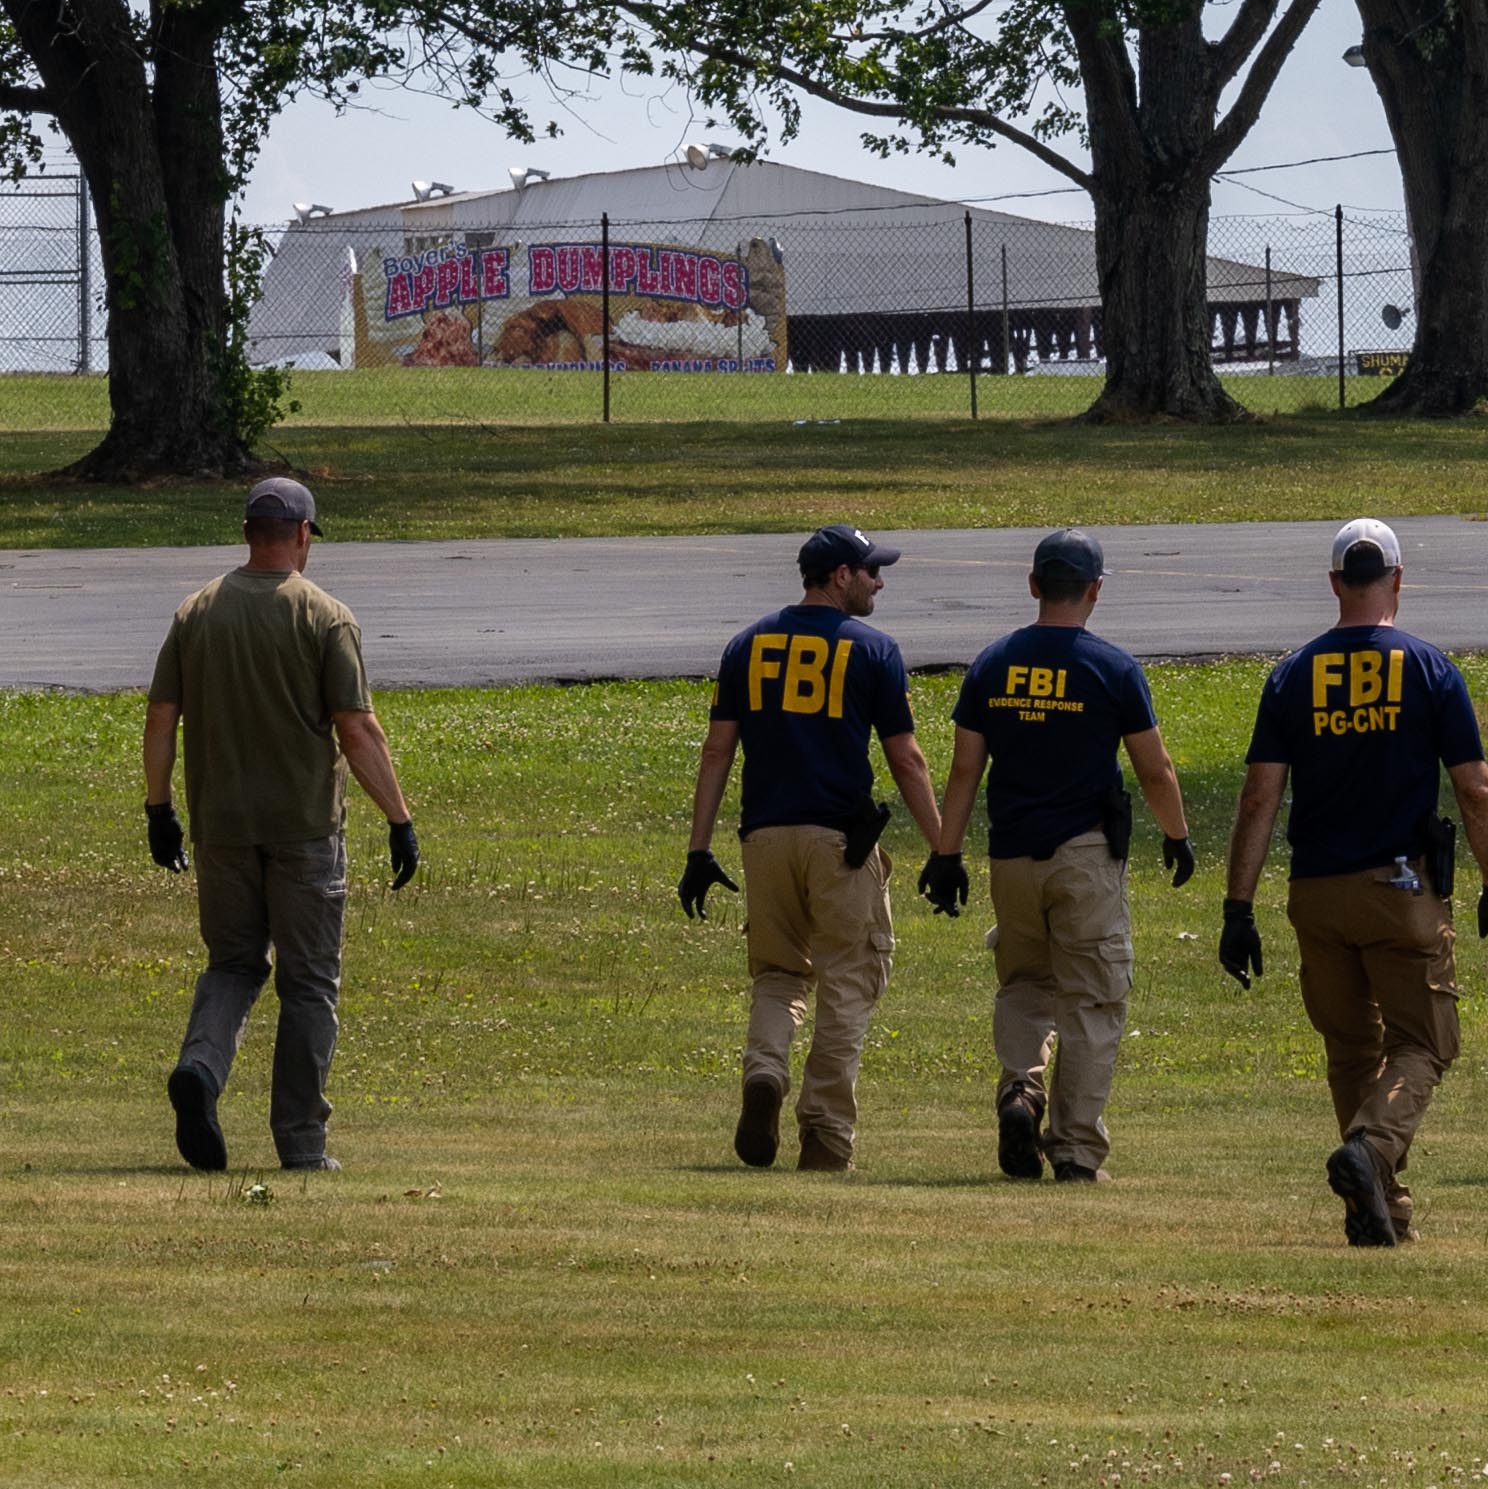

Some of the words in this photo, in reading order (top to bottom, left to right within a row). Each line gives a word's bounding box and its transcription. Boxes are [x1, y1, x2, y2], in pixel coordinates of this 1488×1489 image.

[386, 247, 511, 319] APPLE
[529, 244, 749, 309] DUMPLINGS
[748, 633, 855, 720] FBI
[1005, 665, 1068, 699] FBI
[1311, 649, 1405, 709] FBI
[988, 696, 1032, 710] EVIDENCE
[1033, 698, 1085, 713] RESPONSE
[1017, 710, 1046, 723] TEAM
